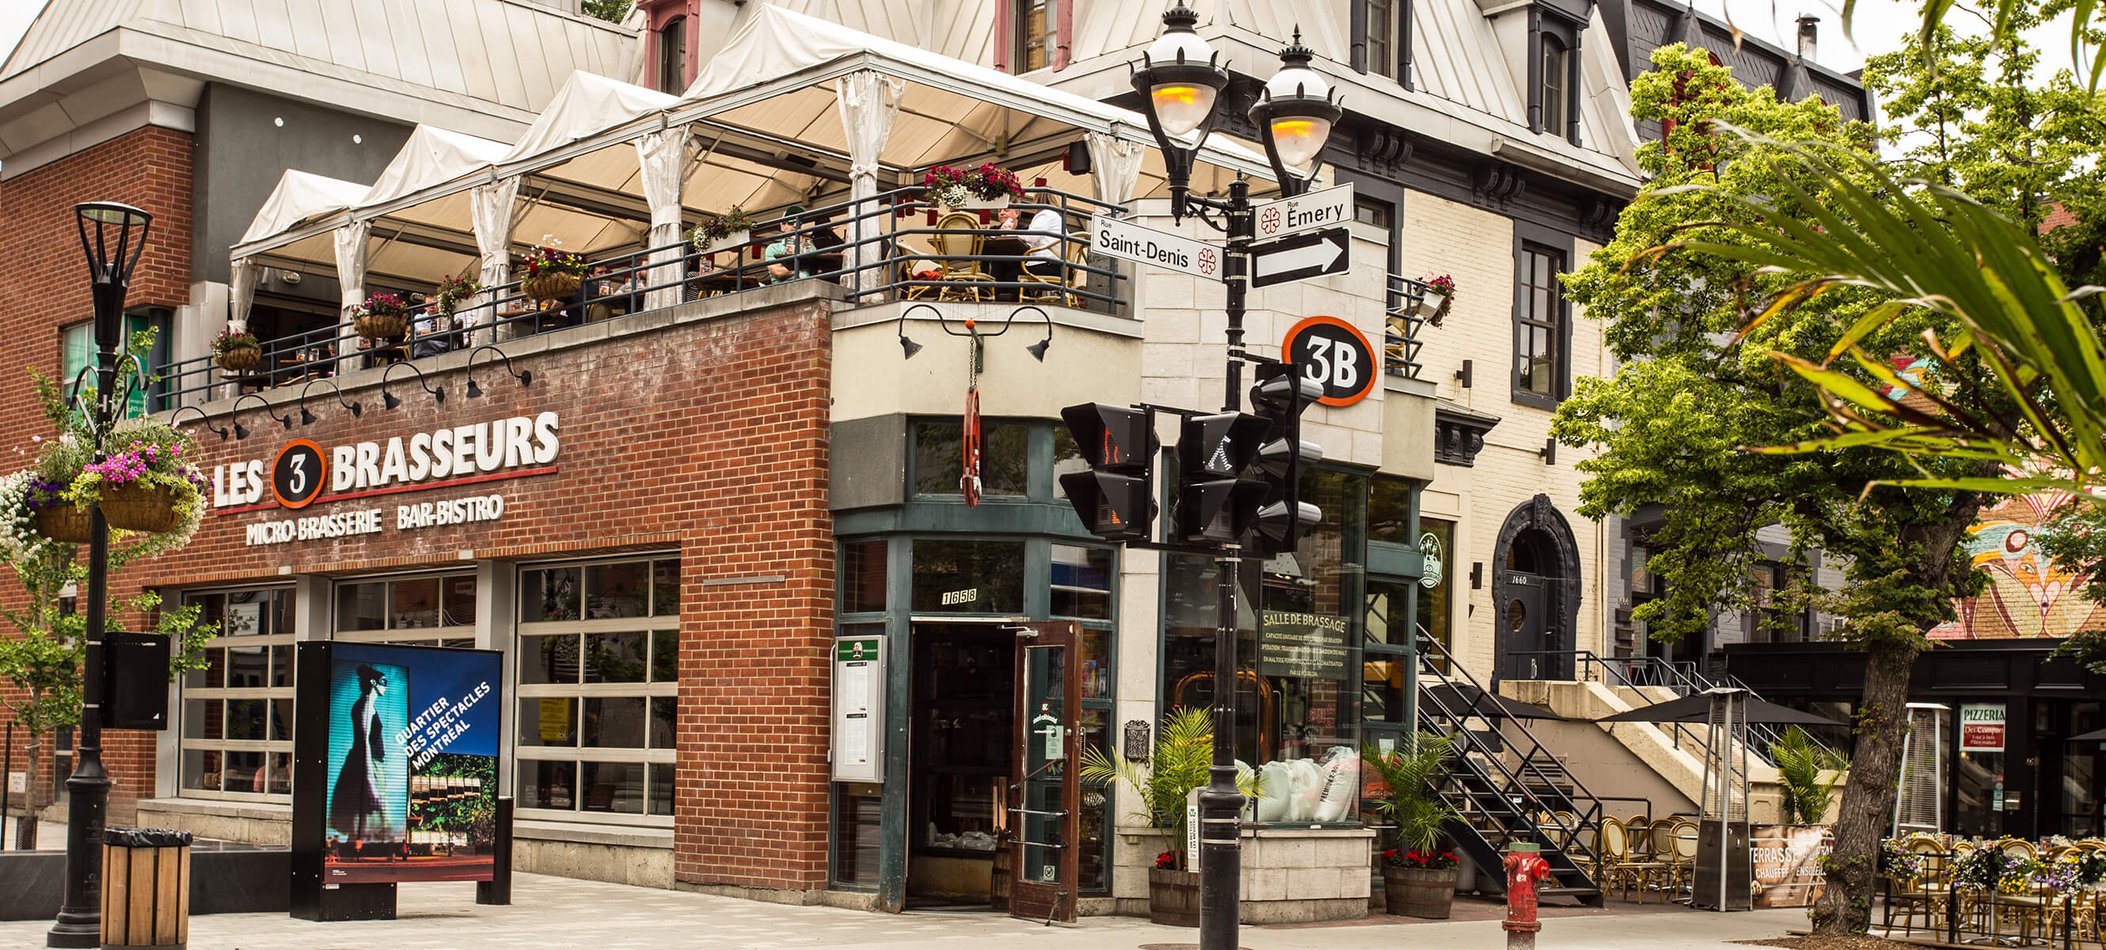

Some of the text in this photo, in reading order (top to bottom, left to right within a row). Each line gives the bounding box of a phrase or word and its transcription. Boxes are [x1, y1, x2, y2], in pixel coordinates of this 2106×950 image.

[1287, 201, 1299, 209] Rue
[1287, 203, 1344, 229] Émery
[1100, 220, 1112, 229] Rue
[1099, 230, 1189, 268] Saint-Denis
[1306, 335, 1357, 389] 3B
[214, 412, 560, 507] LES 3 BRASSEURS
[246, 494, 505, 546] MICRO-BRASSERIE BAR-BISTRO
[943, 589, 977, 605] 1658
[1263, 613, 1346, 633] SALLE DE BRASSAGE
[395, 697, 450, 746] QUARTIER
[403, 681, 491, 758] DES SPECTACLES
[1964, 709, 2006, 721] PIZZERIA
[412, 720, 471, 771] MONTRÉAL
